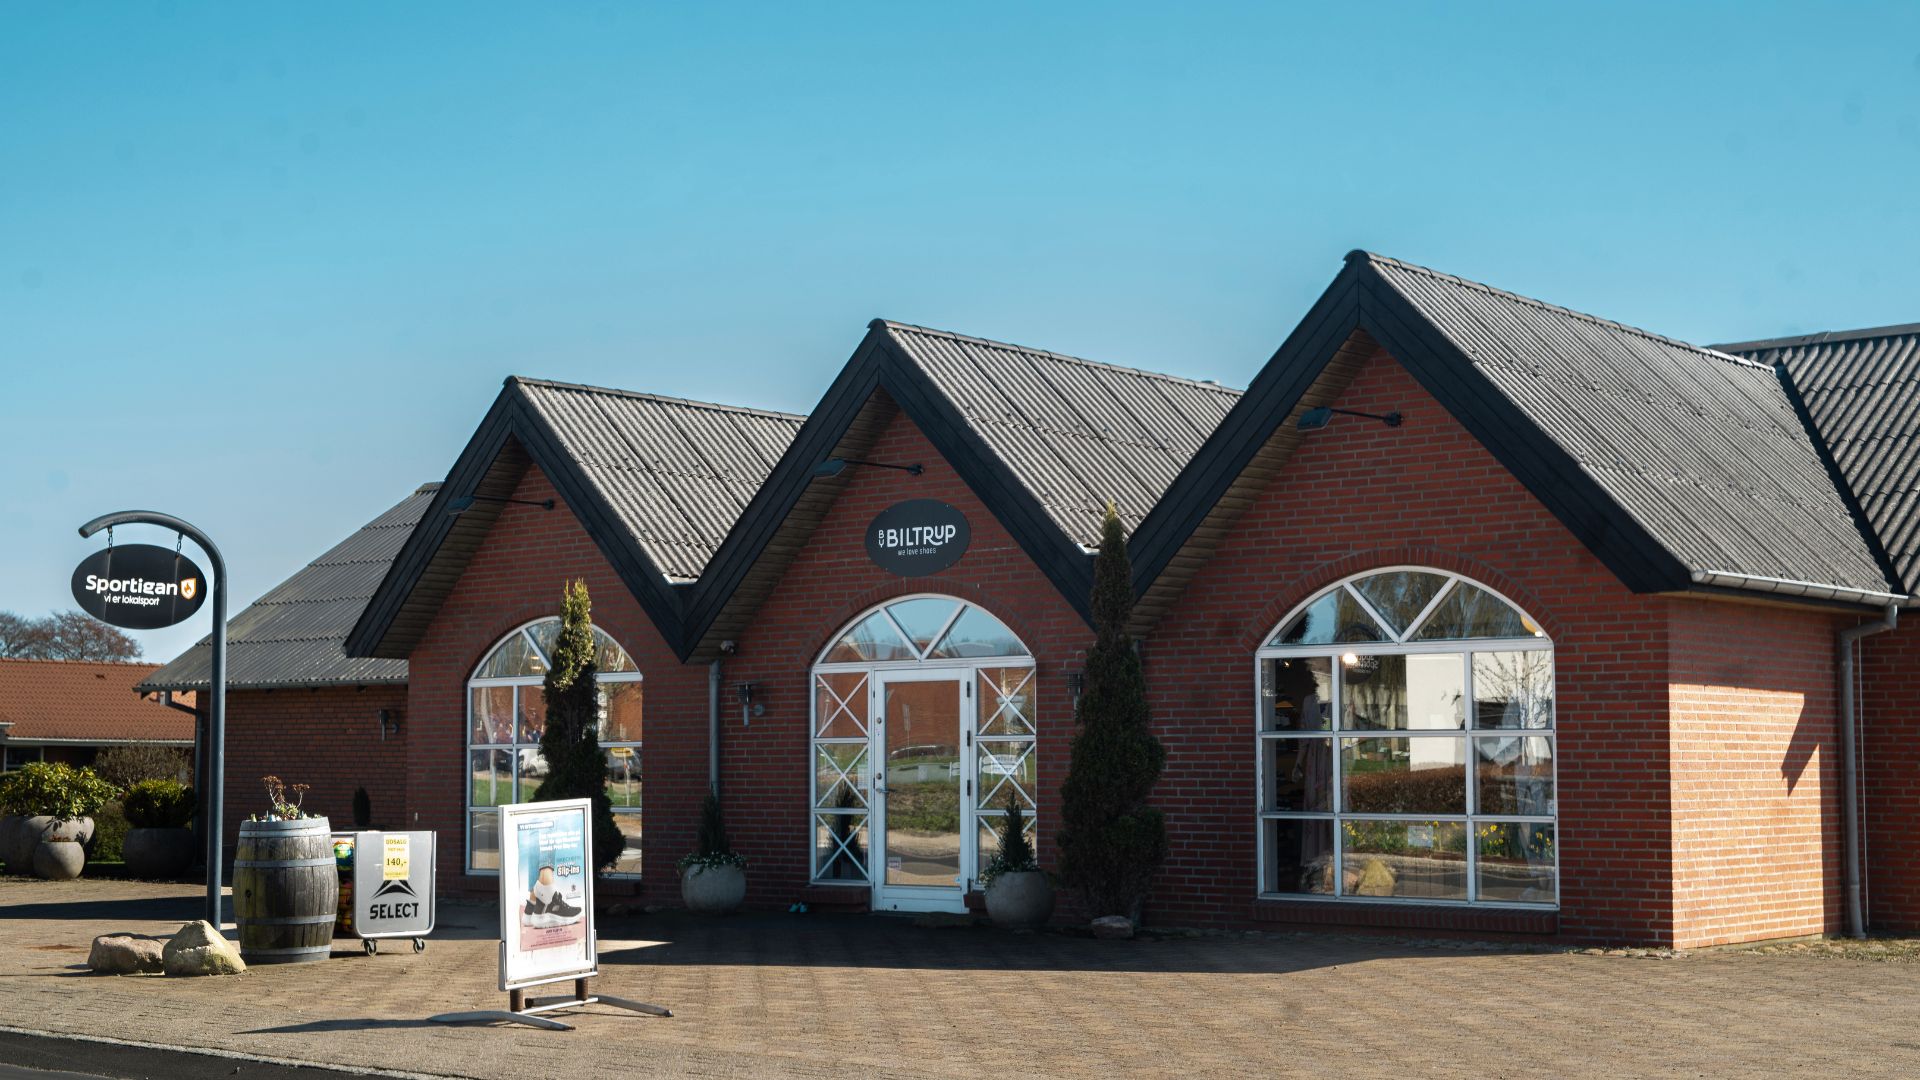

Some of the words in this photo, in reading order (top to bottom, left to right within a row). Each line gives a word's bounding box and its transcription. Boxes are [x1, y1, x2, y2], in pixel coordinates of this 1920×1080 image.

[886, 524, 957, 548] BILTRUP
[919, 546, 937, 555] shoes
[85, 574, 178, 596] Sportigan
[104, 593, 111, 603] vi
[112, 595, 122, 603] er
[122, 595, 160, 607] lokalsport
[386, 858, 407, 867] 140,-
[369, 902, 419, 920] SELECT
